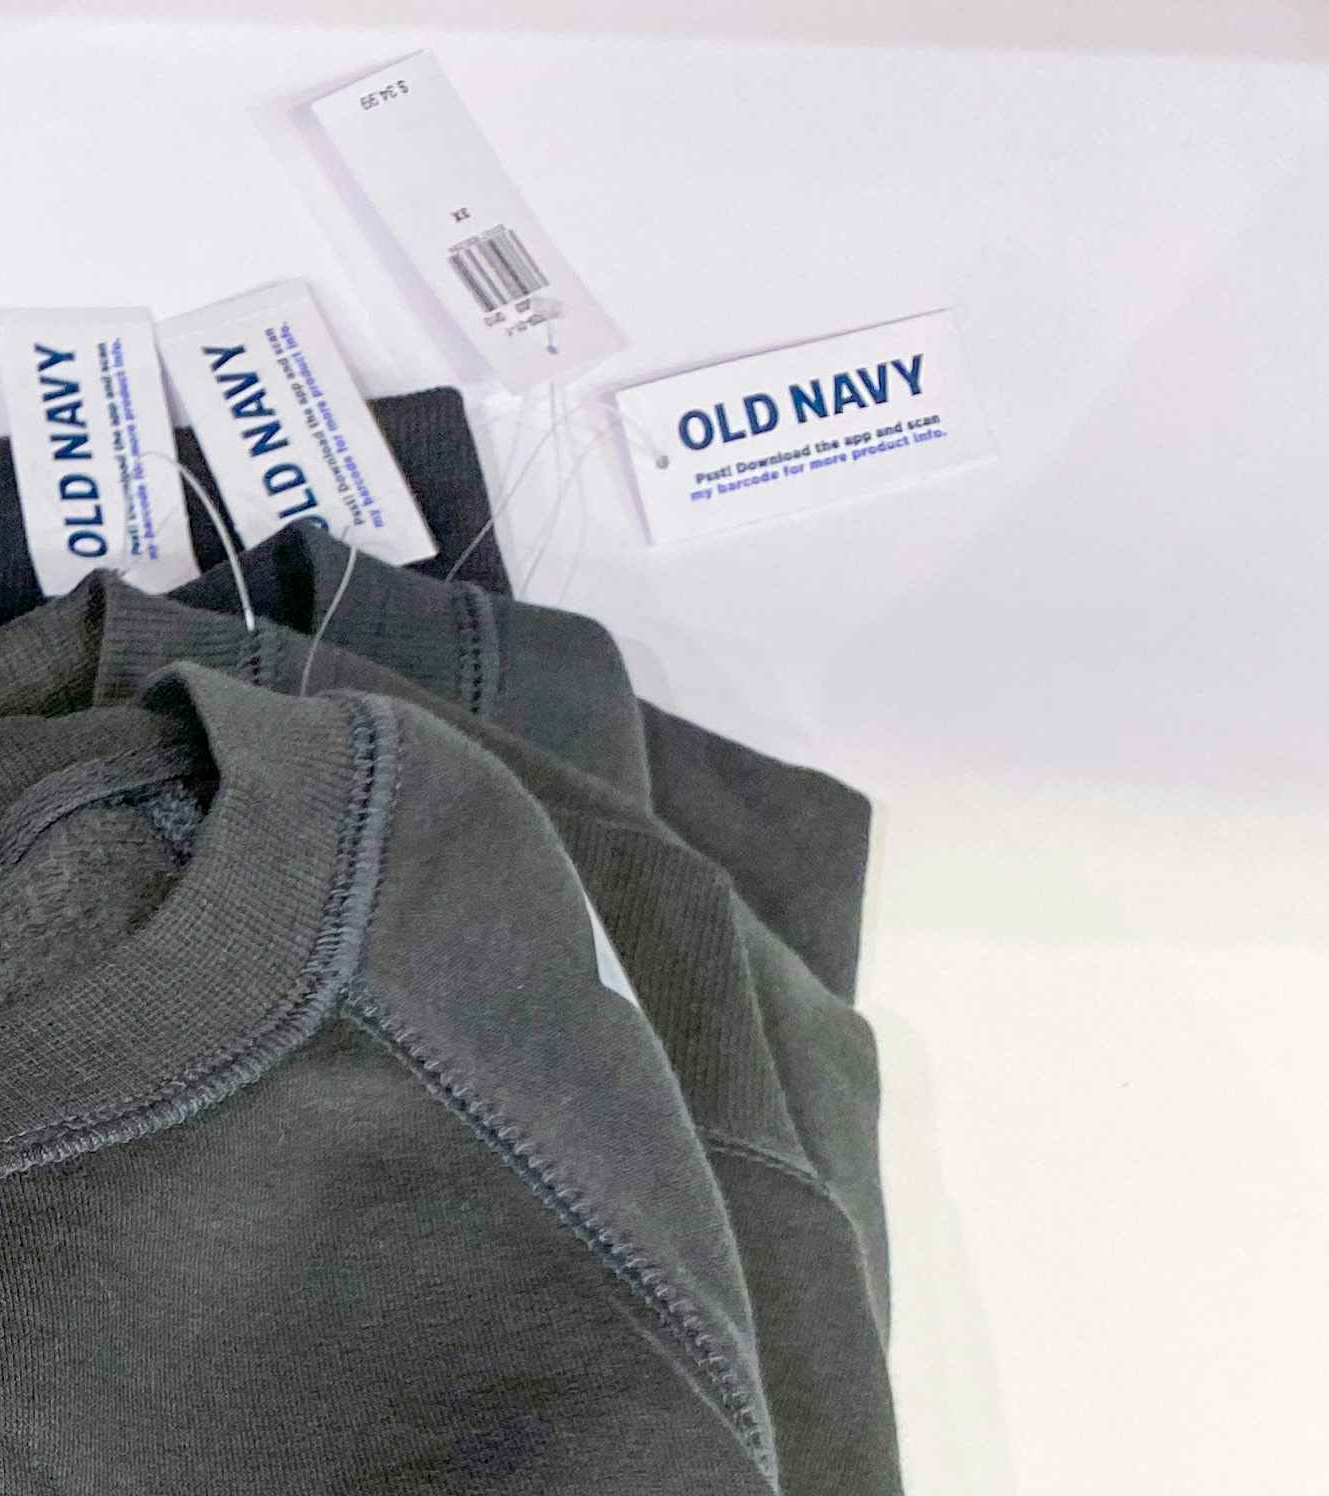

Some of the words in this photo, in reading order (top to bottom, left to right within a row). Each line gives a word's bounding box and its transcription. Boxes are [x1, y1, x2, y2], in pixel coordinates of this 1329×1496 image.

[264, 328, 284, 356] scan
[278, 358, 295, 380] and
[34, 342, 92, 461] NAVY
[202, 343, 290, 458] NAVY
[291, 382, 308, 406] app
[292, 351, 324, 399] product
[679, 393, 780, 451] OLD
[789, 354, 924, 424] NAVY
[303, 408, 321, 429] the
[316, 401, 339, 432] more
[313, 431, 351, 493] Download
[690, 489, 712, 501] my
[717, 469, 779, 494] barcode
[783, 463, 805, 478] for
[809, 453, 847, 470] more
[852, 436, 910, 461] product
[913, 428, 948, 445] info.
[695, 465, 732, 485] Psst!
[736, 445, 811, 474] Download
[815, 437, 839, 455] the
[844, 433, 871, 451] app
[876, 422, 903, 438] and
[907, 414, 941, 431] scan
[343, 455, 375, 507] barcode
[59, 472, 108, 558] OLD
